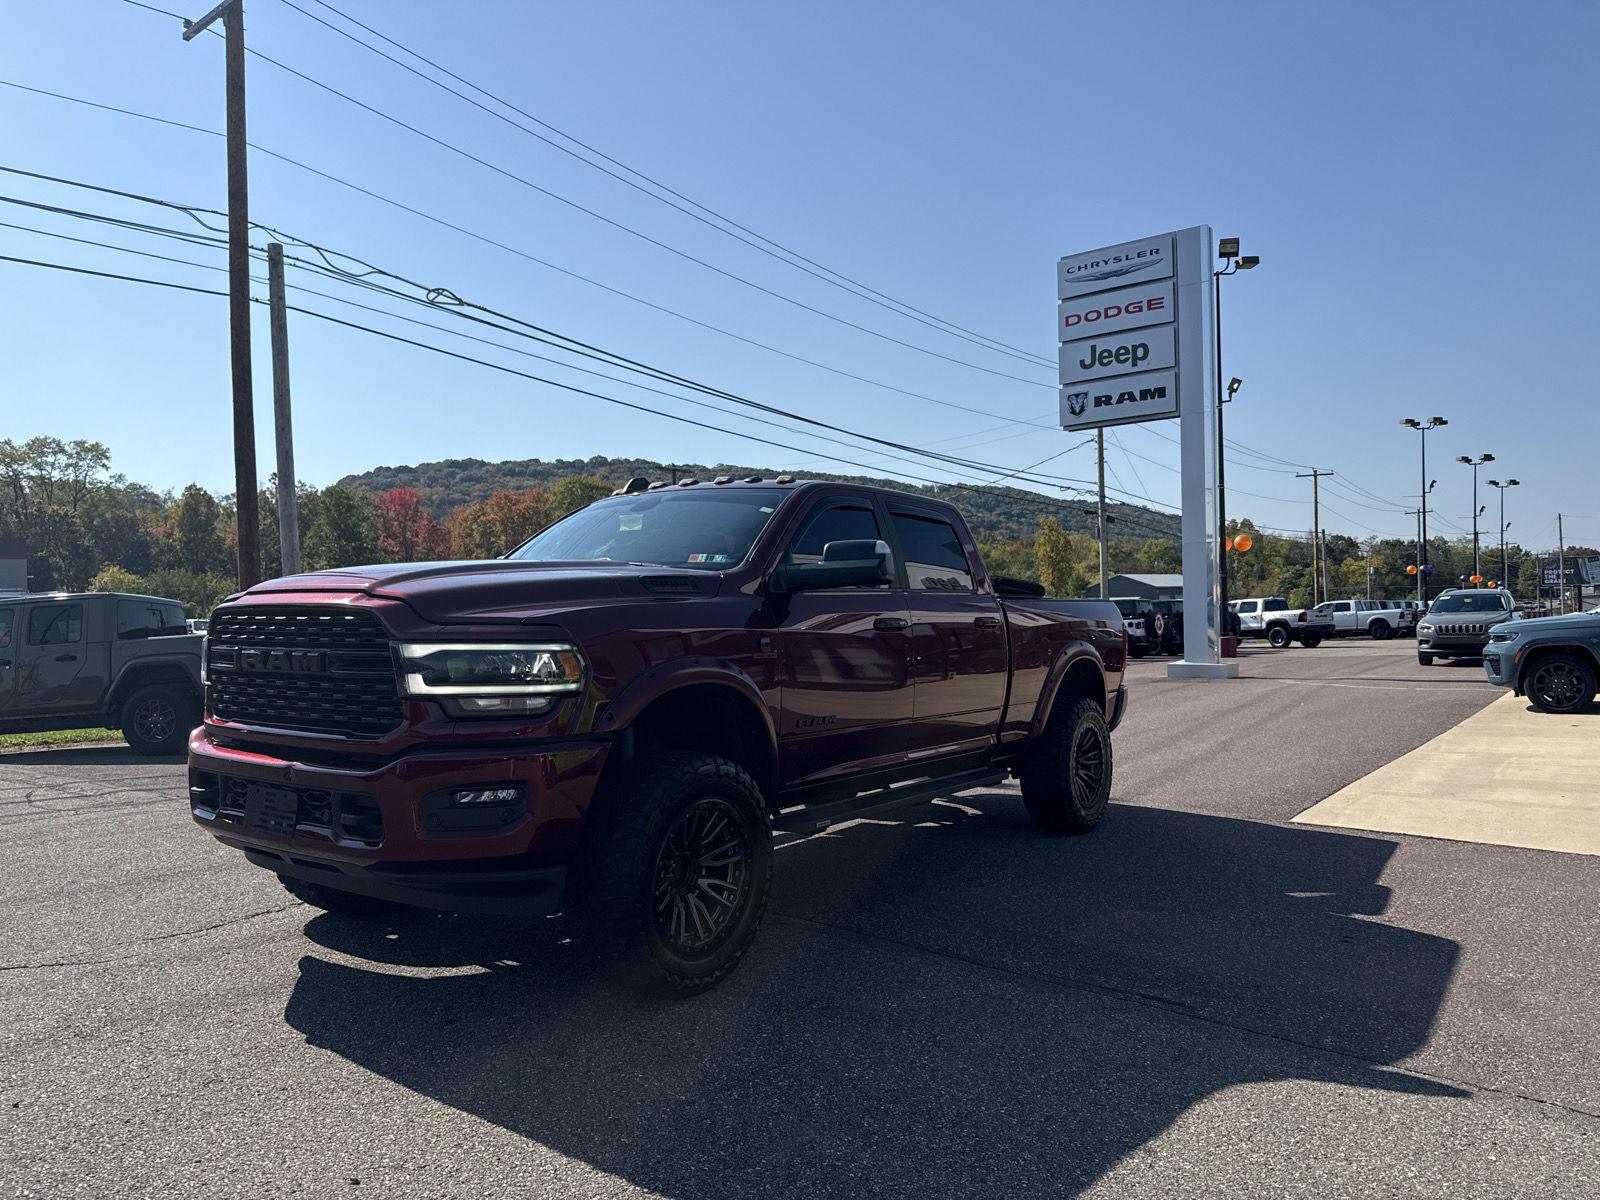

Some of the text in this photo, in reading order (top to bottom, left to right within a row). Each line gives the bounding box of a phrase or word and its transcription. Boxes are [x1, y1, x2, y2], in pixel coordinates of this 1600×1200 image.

[1066, 248, 1161, 274] CHRYSLER
[1065, 297, 1165, 327] DODGE
[1079, 342, 1150, 370] Jeep
[1093, 386, 1167, 409] RAM
[241, 649, 323, 673] RAM
